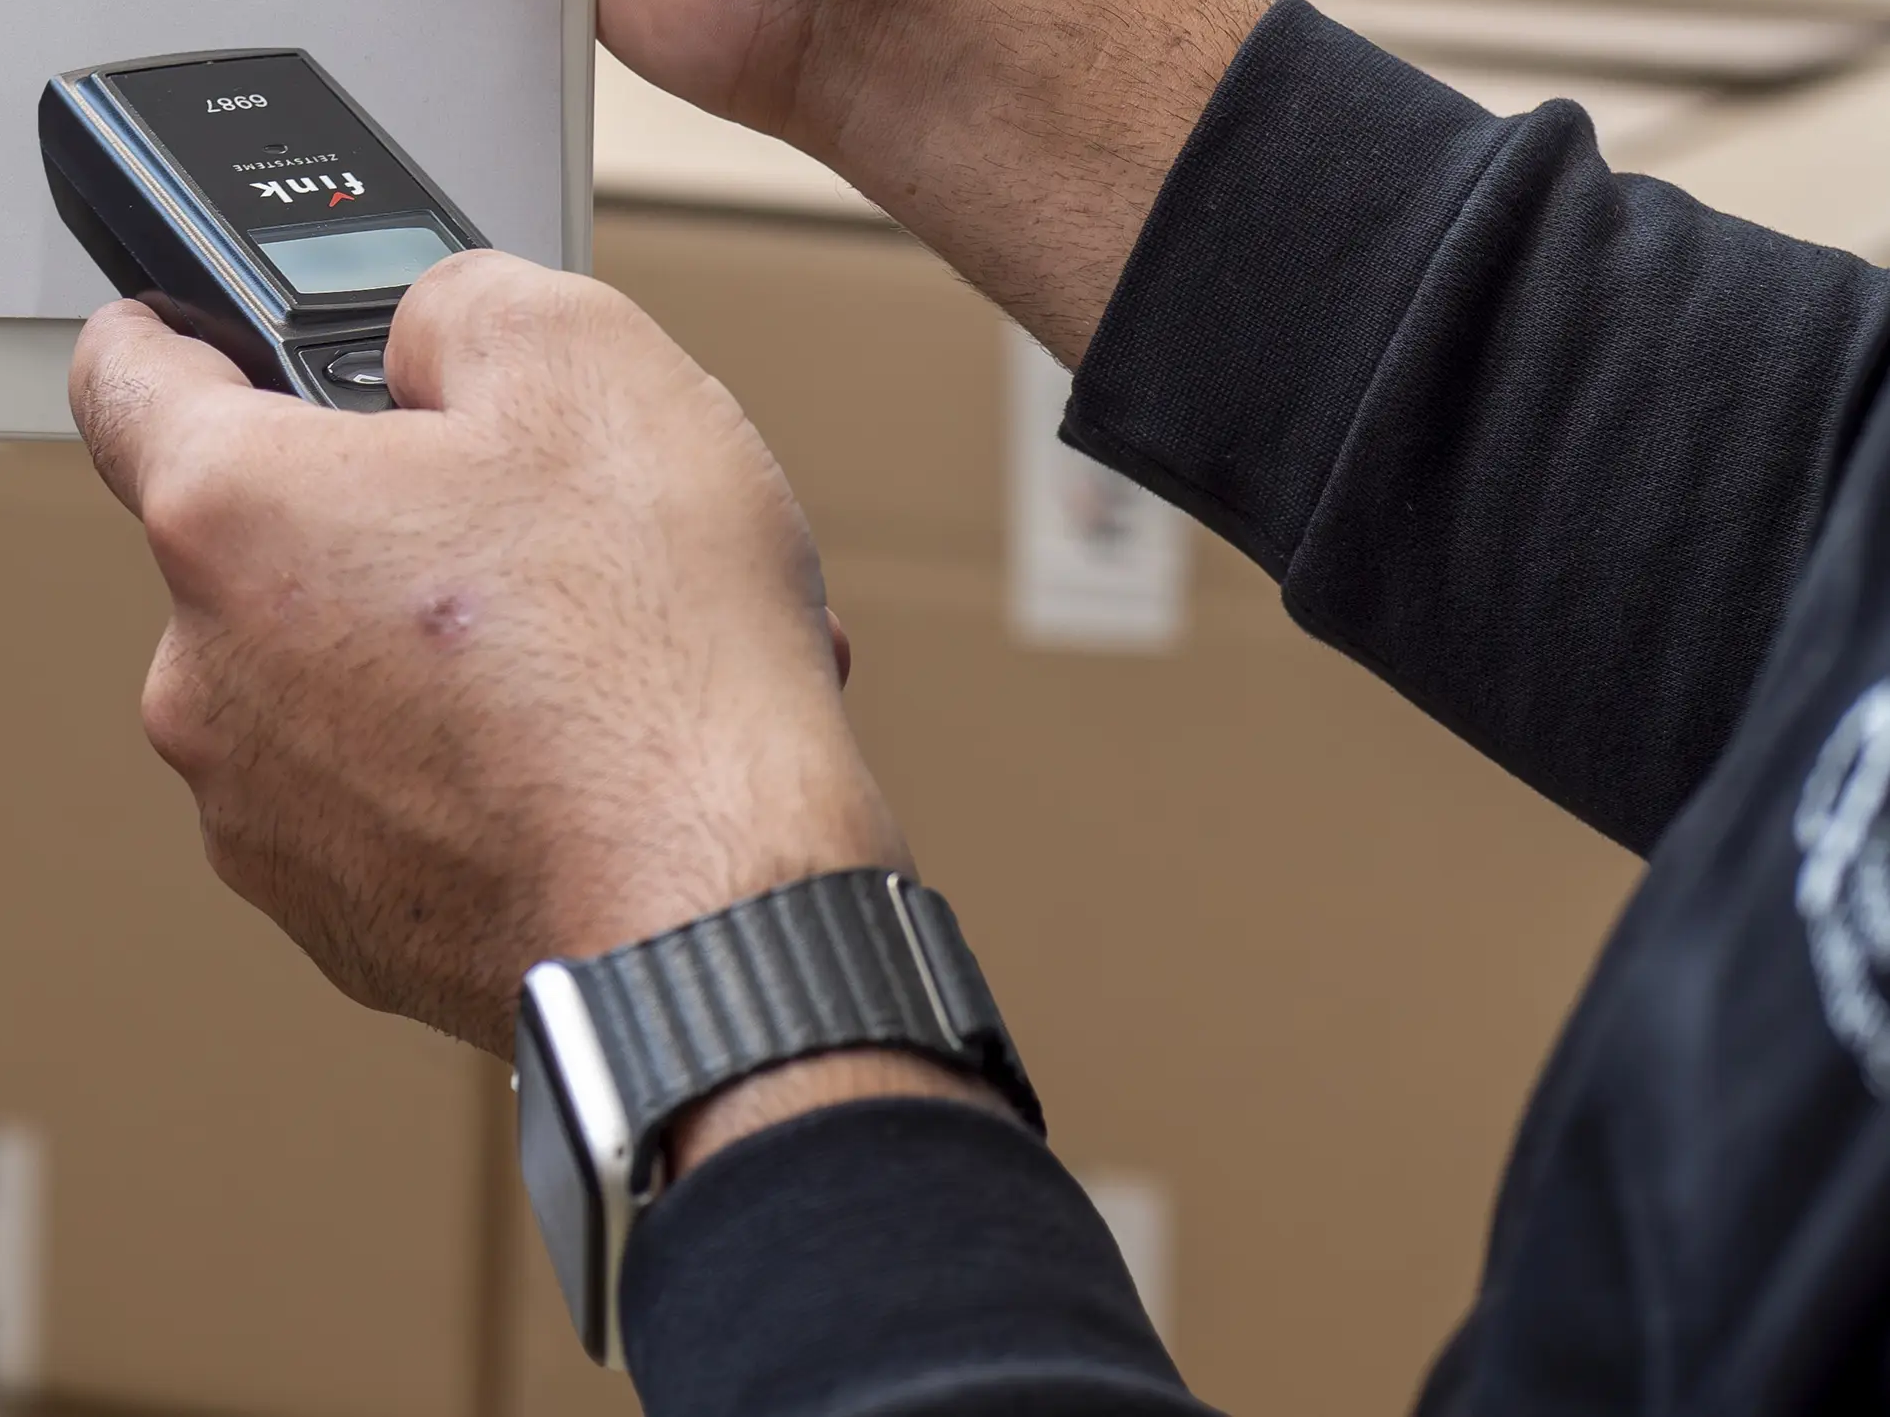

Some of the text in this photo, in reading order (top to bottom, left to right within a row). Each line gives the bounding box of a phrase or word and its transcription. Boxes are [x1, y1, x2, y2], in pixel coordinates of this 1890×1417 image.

[206, 93, 268, 113] 6987
[233, 153, 339, 173] ZEITSYSTEME
[248, 172, 366, 208] fink
